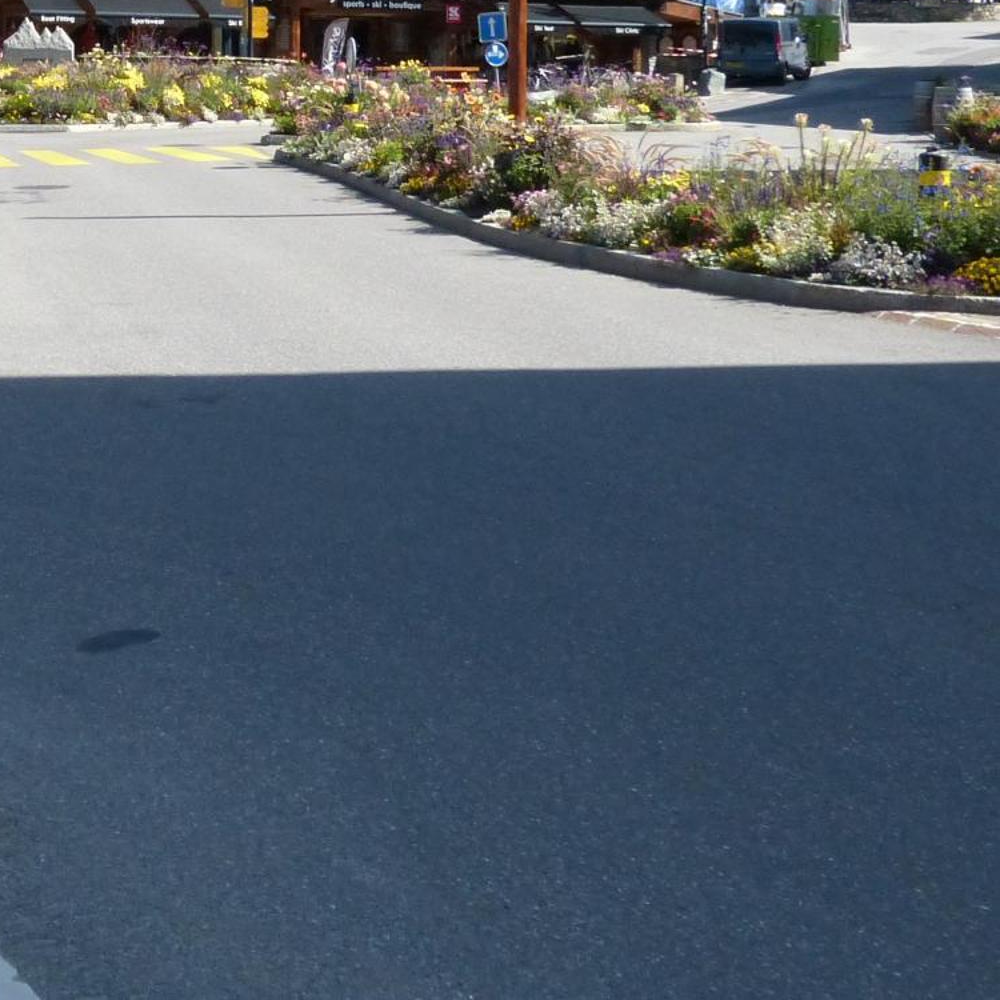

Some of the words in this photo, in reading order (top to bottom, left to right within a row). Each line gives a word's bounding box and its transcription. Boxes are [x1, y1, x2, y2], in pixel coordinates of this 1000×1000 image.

[343, 0, 365, 9] sports
[371, 1, 382, 9] ski
[389, 1, 421, 10] boutique
